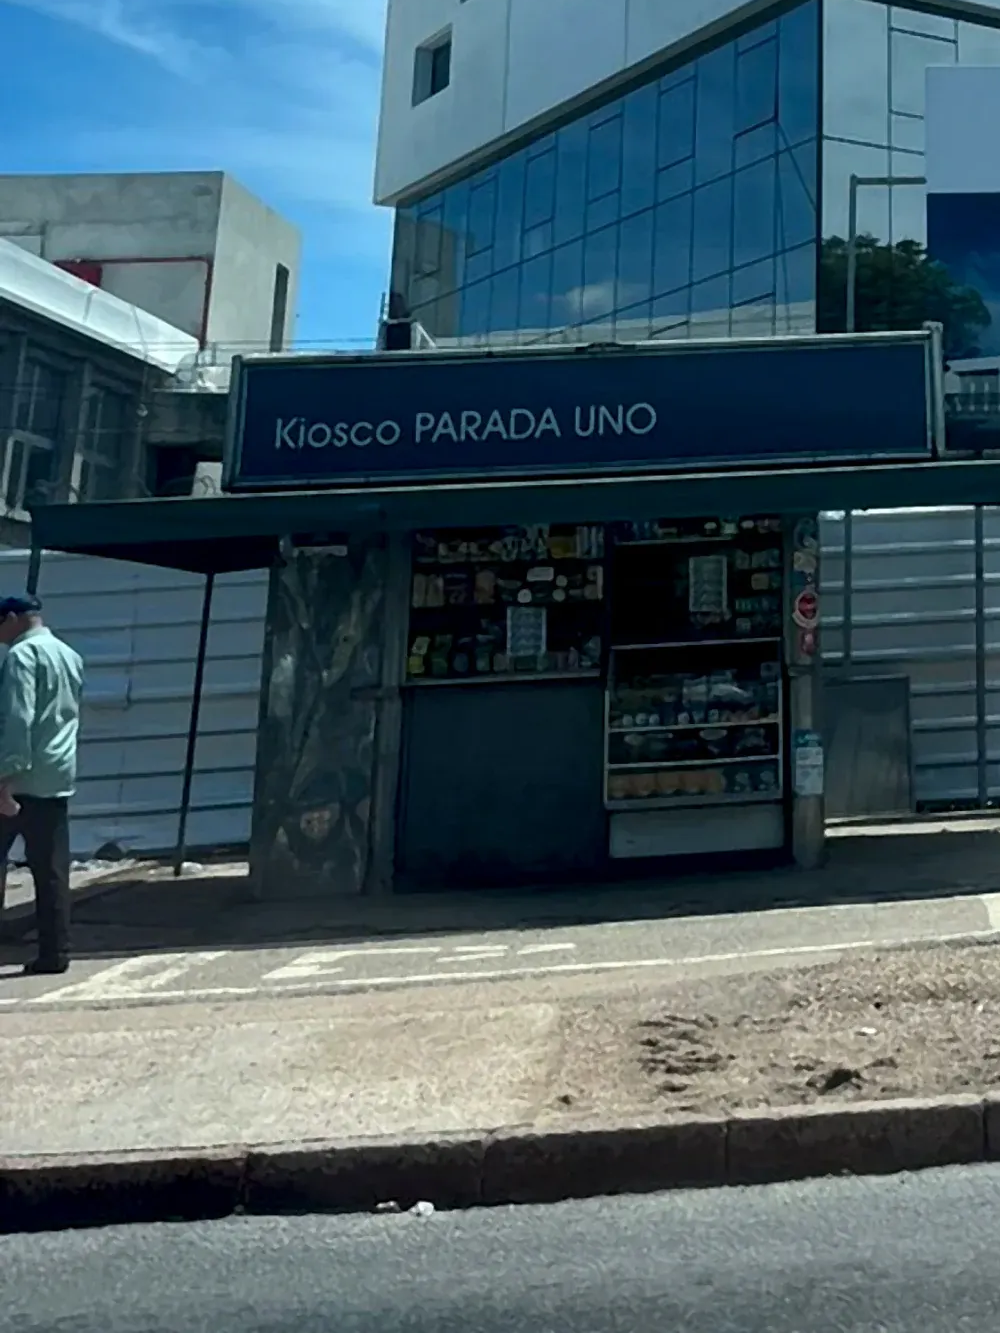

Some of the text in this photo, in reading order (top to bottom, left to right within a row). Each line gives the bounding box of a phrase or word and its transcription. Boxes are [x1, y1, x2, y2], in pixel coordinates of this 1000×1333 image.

[275, 402, 657, 449] Kiosco PARADA UNO
